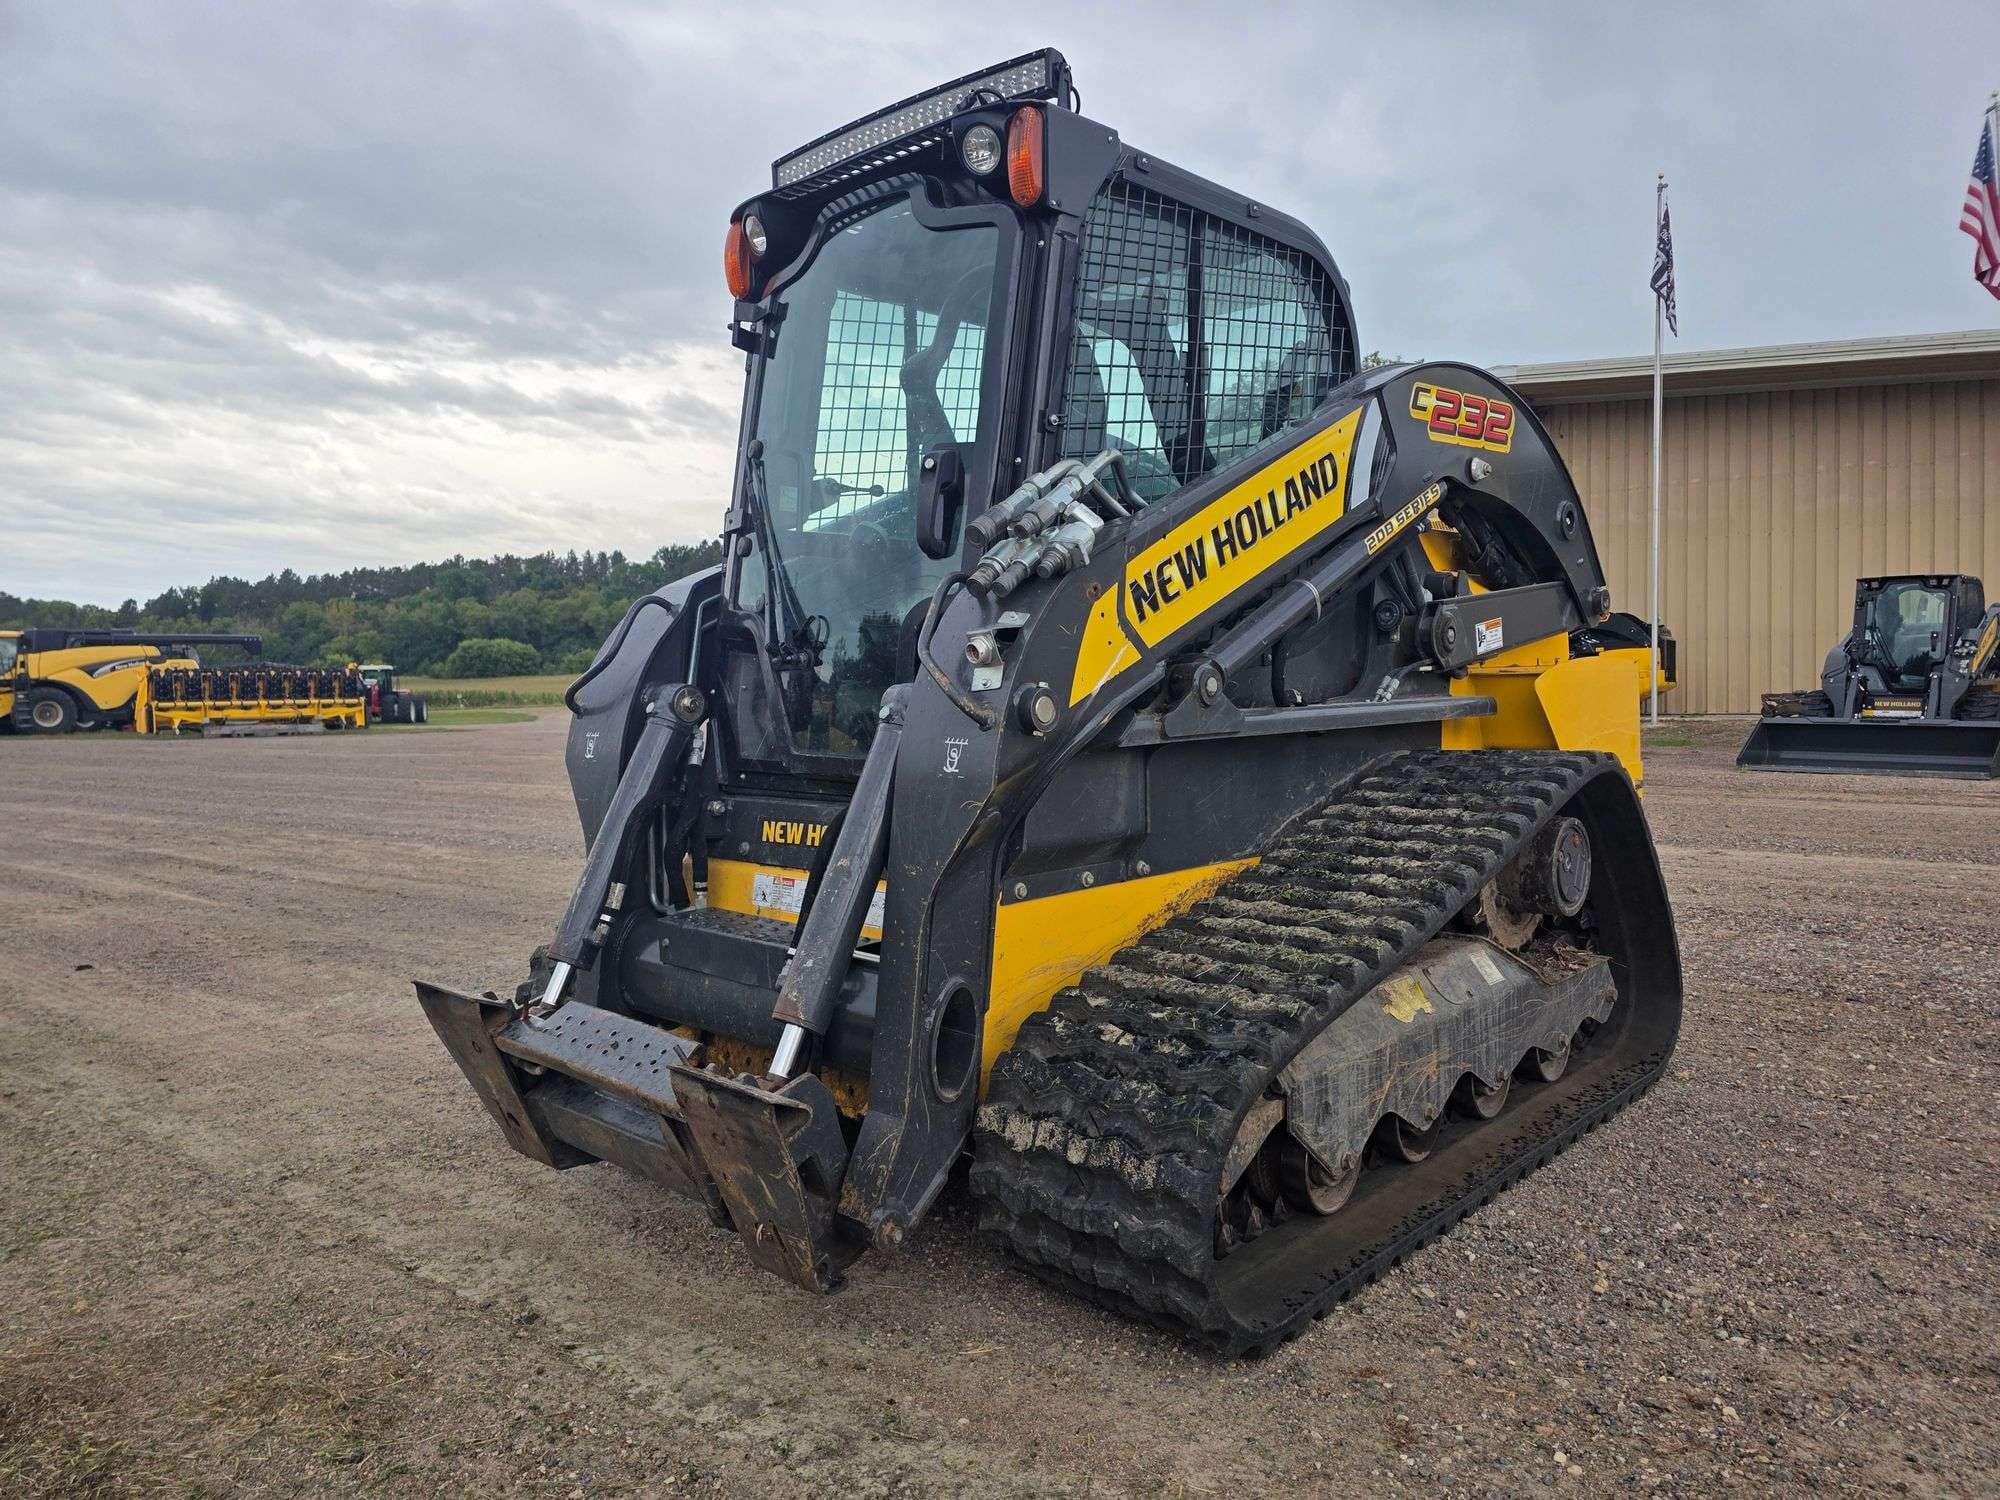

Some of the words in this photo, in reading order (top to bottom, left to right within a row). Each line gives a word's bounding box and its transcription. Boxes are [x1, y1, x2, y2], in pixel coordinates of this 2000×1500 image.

[1395, 484, 1439, 527] SERIES
[1128, 534, 1208, 624] NEW
[1210, 452, 1339, 568] HOLLAND
[761, 820, 804, 845] NEW
[806, 823, 829, 847] H
